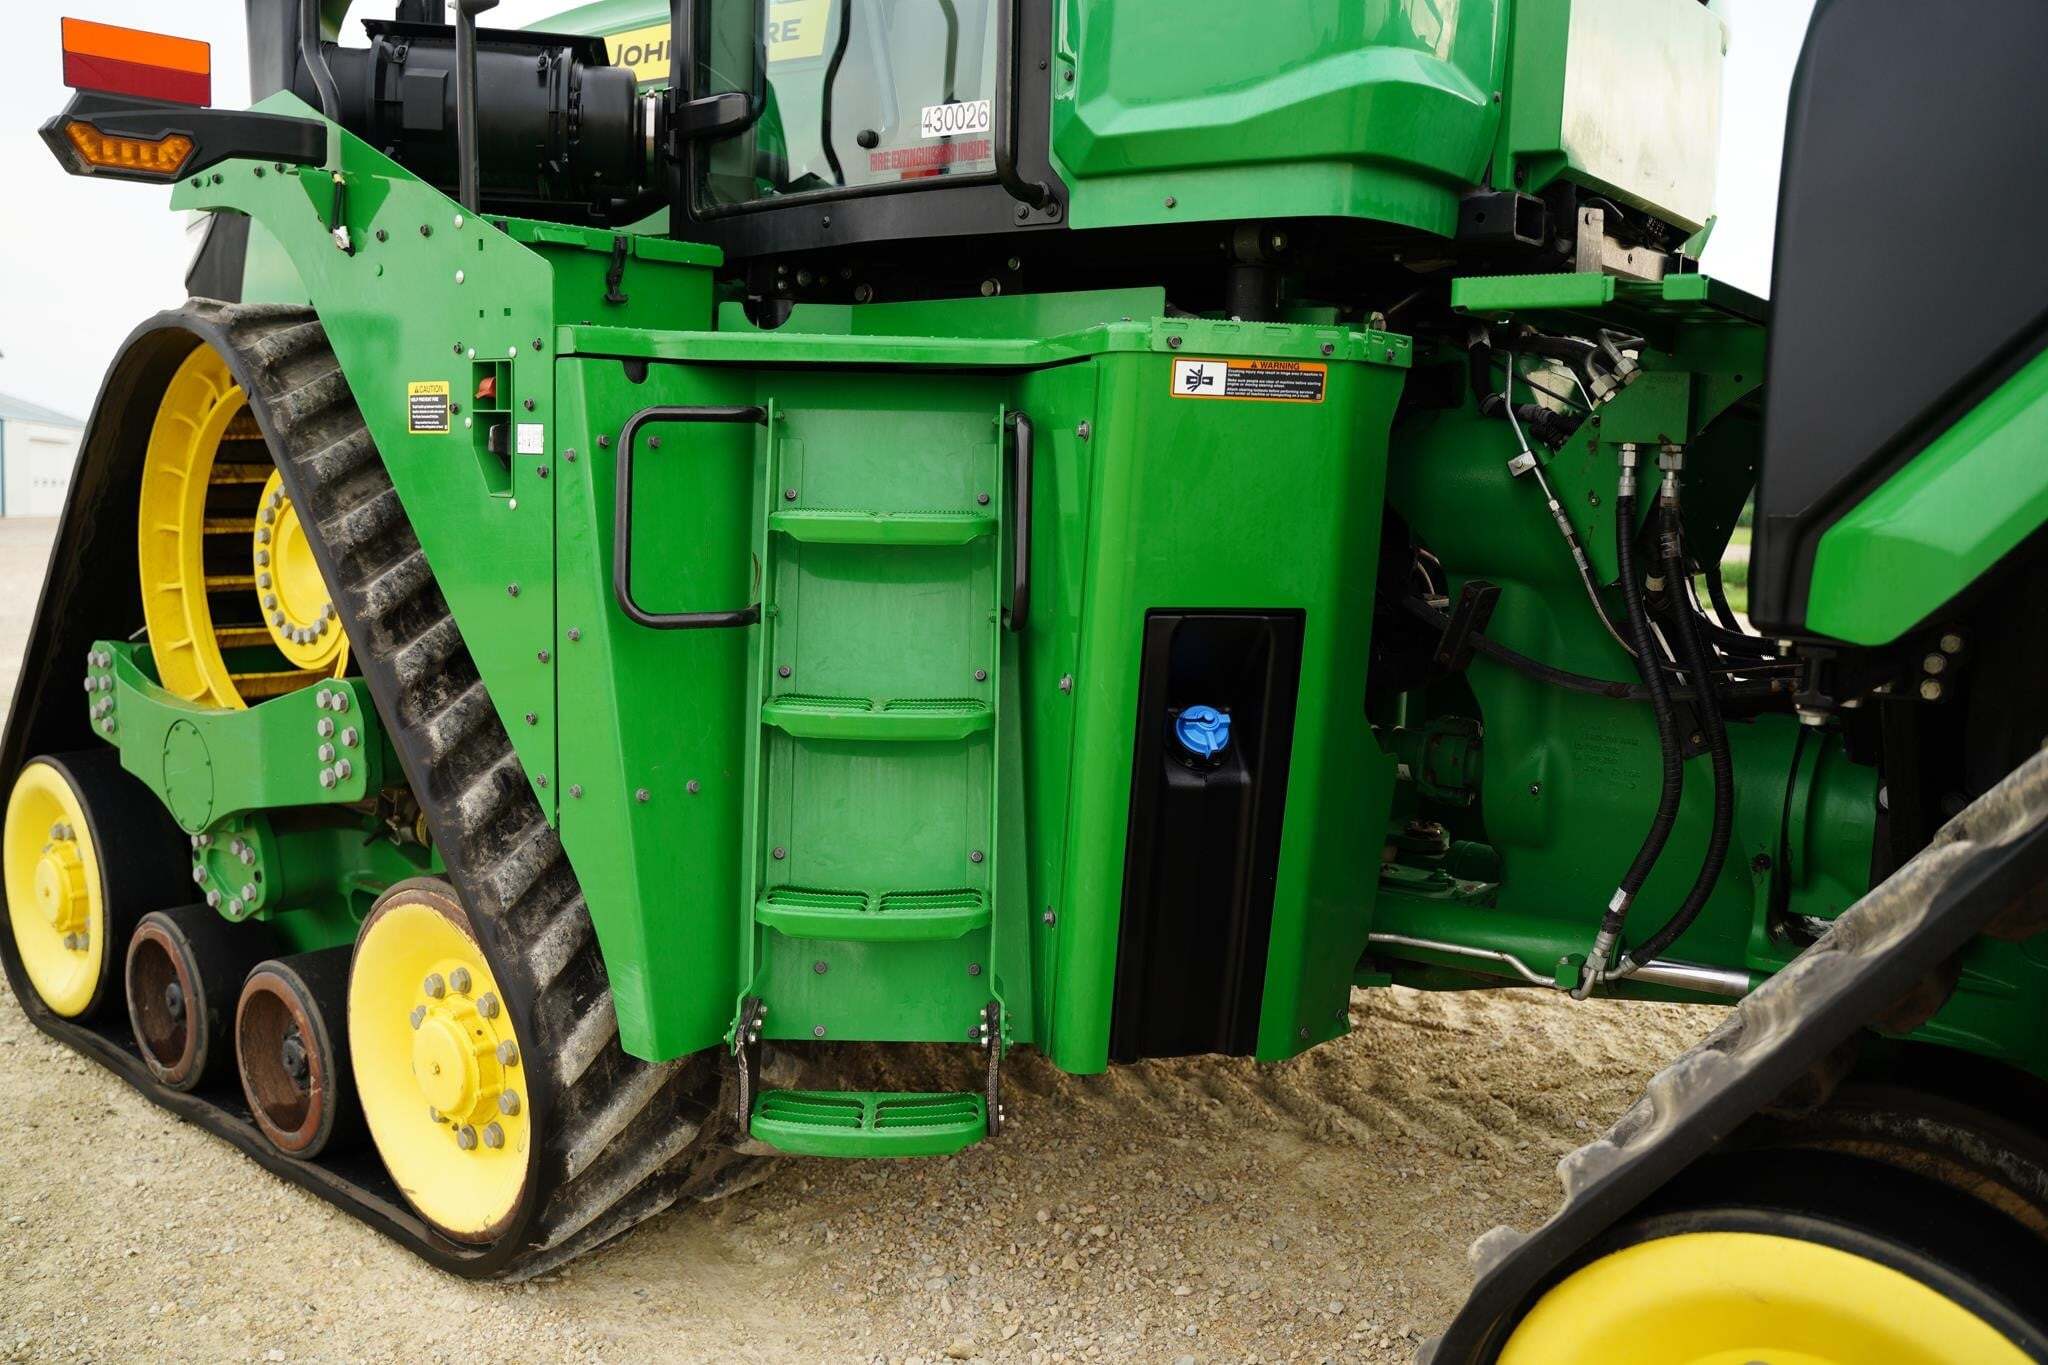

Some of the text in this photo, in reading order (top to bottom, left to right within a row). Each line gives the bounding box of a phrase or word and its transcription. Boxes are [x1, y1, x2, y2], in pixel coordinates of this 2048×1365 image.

[612, 39, 671, 67] JOH
[923, 102, 988, 133] 430026
[870, 151, 891, 172] FIRE
[958, 139, 992, 161] INSIDE
[1260, 362, 1300, 370] WARNING
[420, 385, 443, 393] CAUTION
